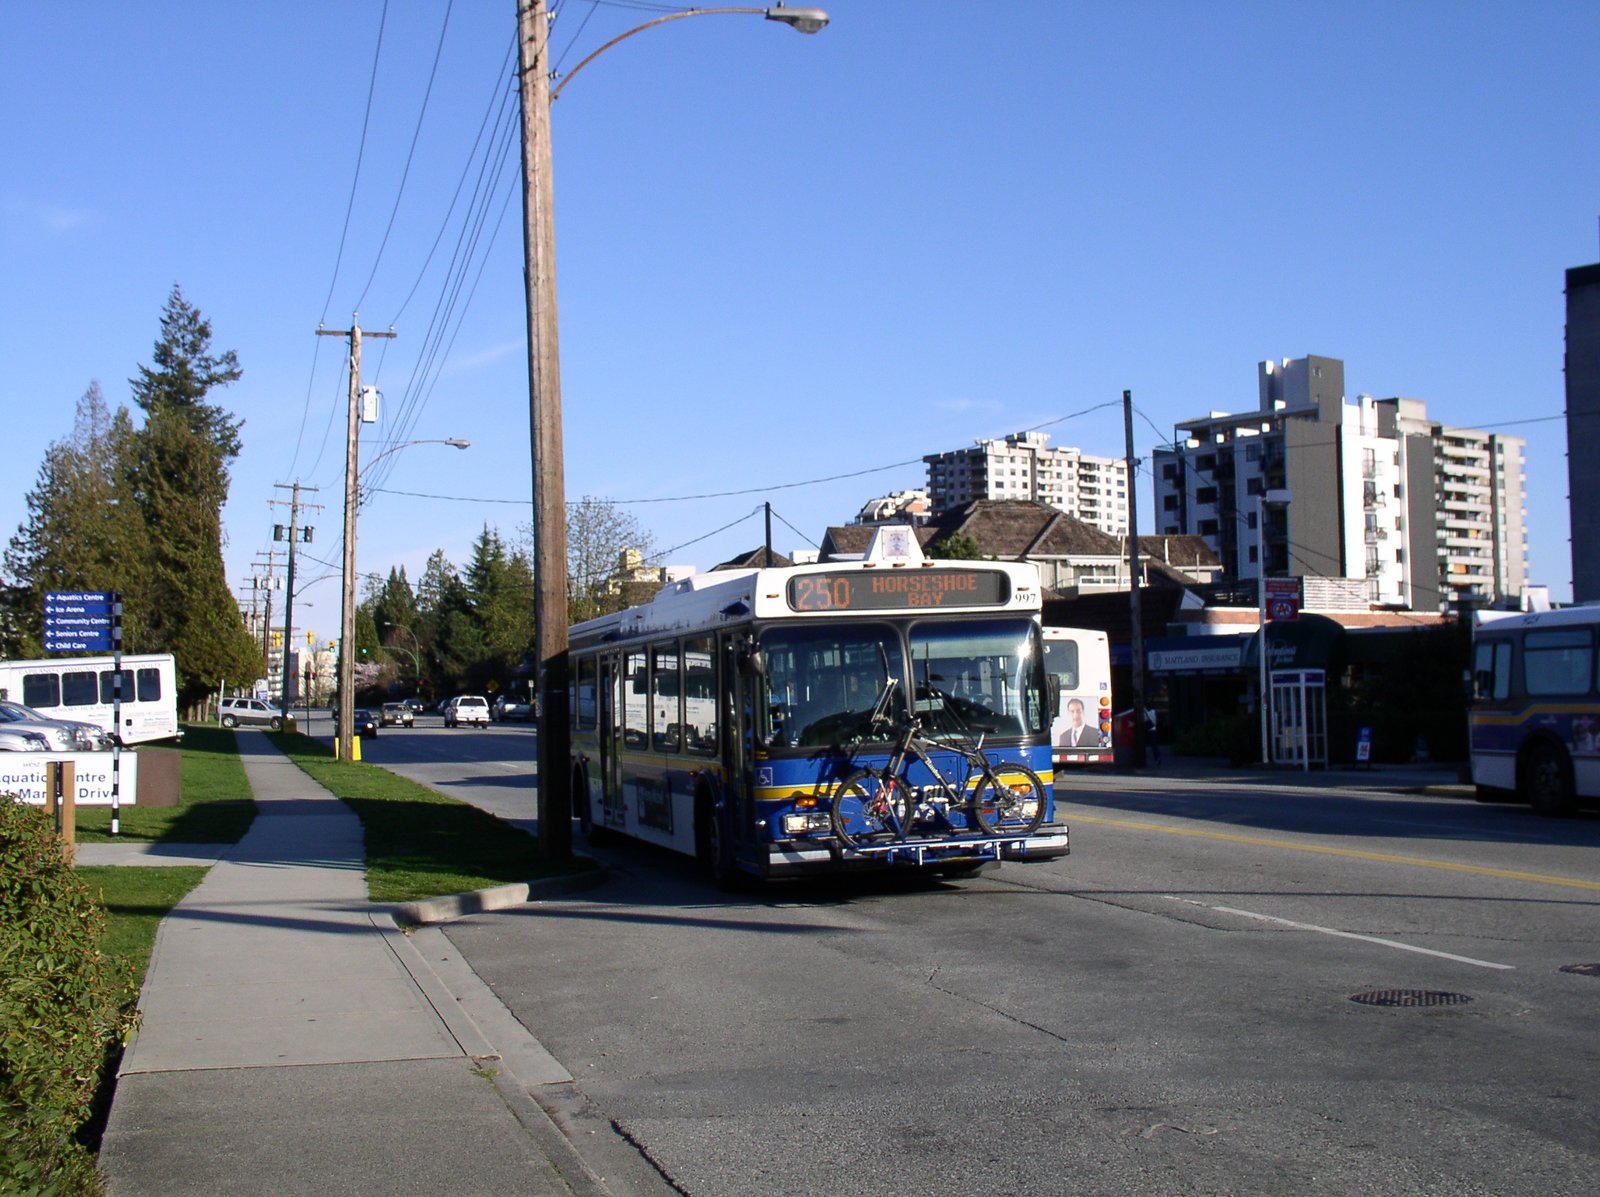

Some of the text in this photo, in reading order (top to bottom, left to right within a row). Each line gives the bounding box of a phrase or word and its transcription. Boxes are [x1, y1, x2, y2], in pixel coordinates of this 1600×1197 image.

[873, 573, 978, 594] HORSESHOE
[56, 594, 82, 602] Aquatics
[798, 577, 945, 611] 250 BAY
[1014, 593, 1036, 603] 997
[55, 618, 90, 626] Community
[75, 773, 107, 783] ntre
